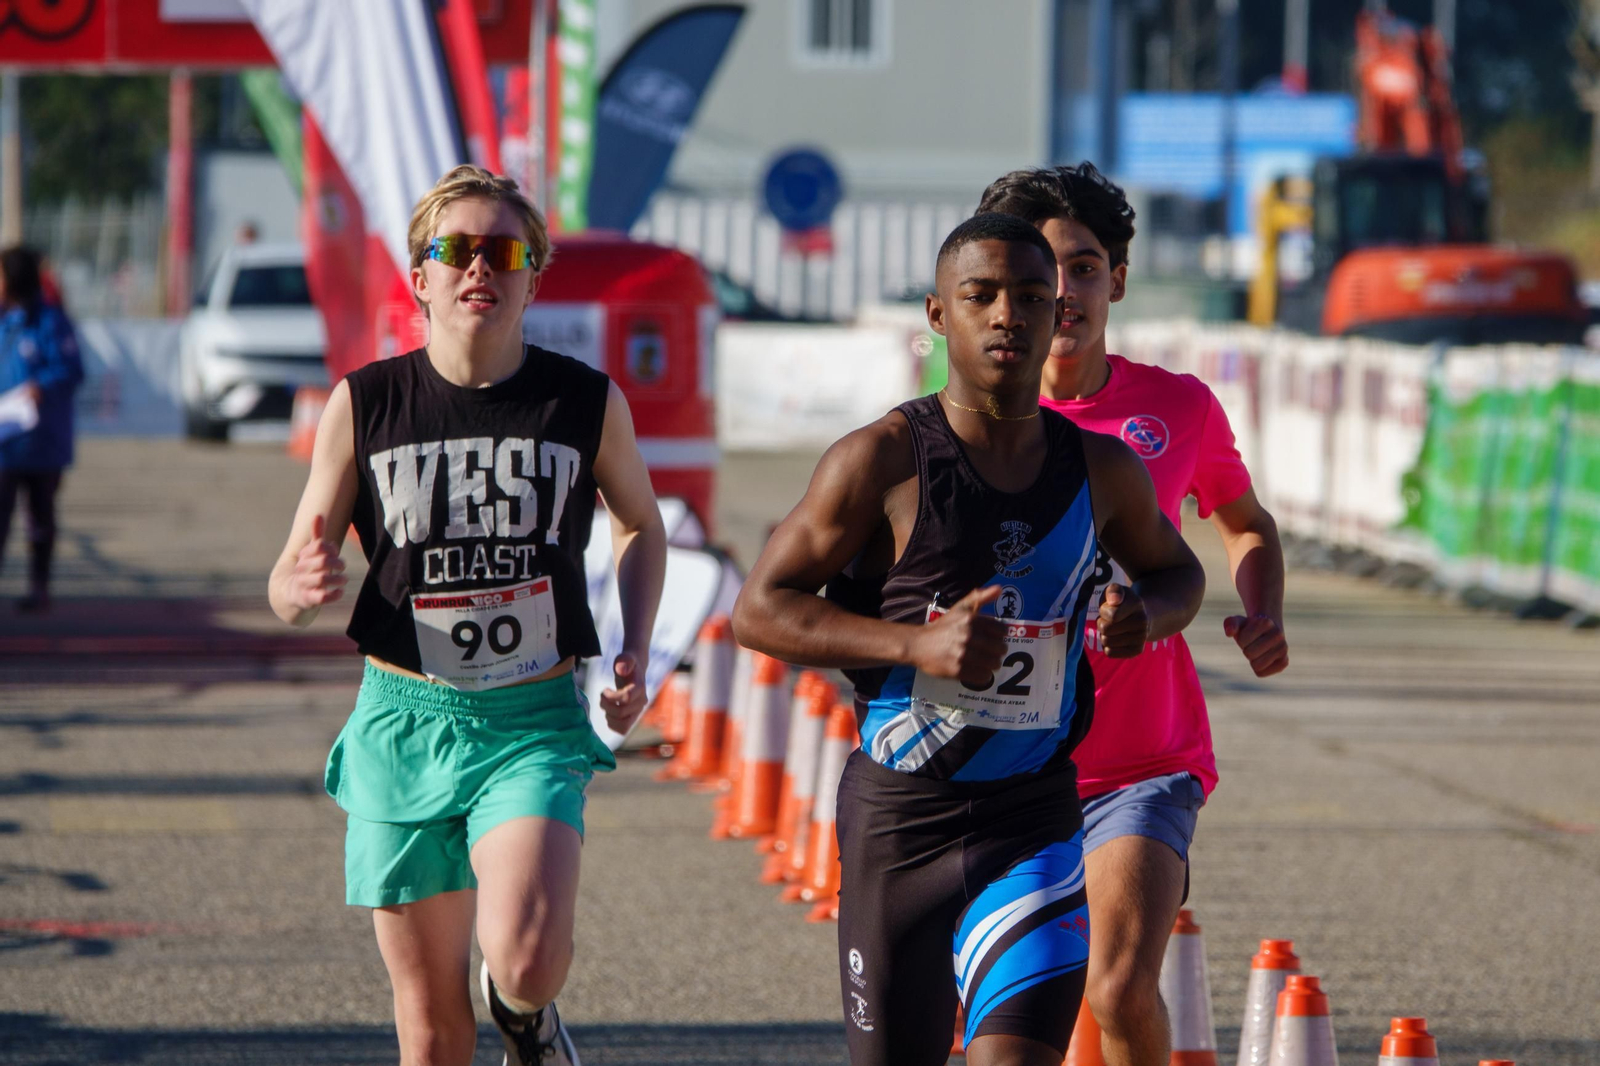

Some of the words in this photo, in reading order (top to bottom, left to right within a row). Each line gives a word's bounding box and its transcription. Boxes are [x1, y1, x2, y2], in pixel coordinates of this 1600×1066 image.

[370, 437, 580, 548] WEST
[423, 544, 536, 584] COAST
[451, 614, 523, 662] 90
[980, 697, 1008, 706] FERREIRA
